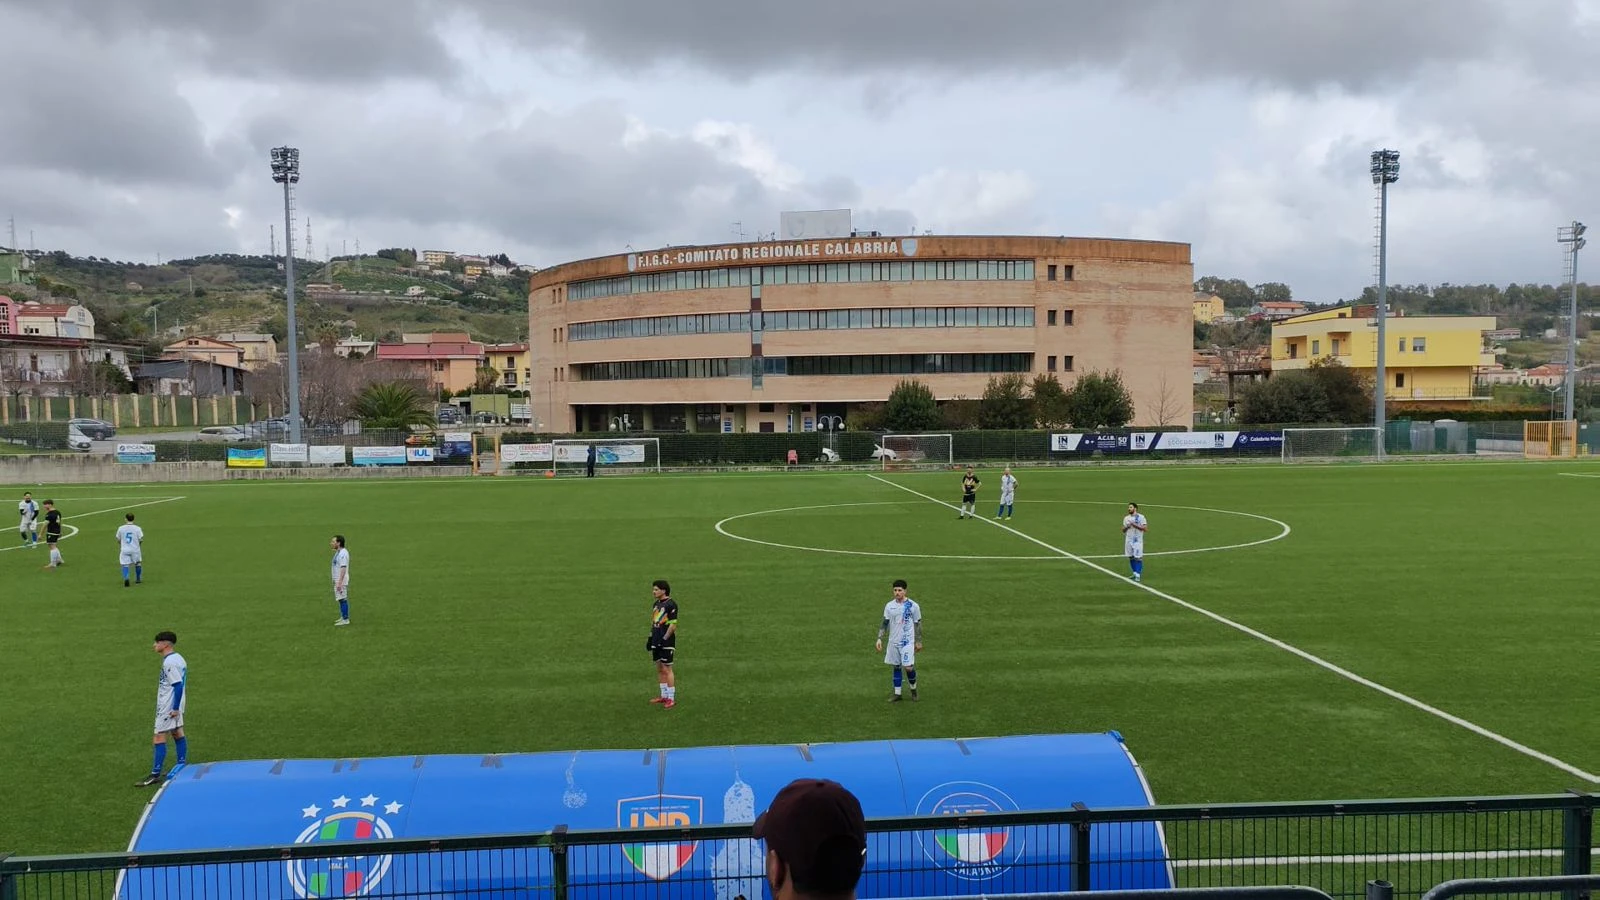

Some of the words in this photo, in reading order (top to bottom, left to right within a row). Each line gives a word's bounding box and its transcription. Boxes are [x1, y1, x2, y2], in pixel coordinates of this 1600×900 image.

[742, 243, 820, 259] REGIONALE
[824, 241, 898, 255] CALABRIA
[125, 532, 133, 544] 5
[903, 651, 909, 661] 6
